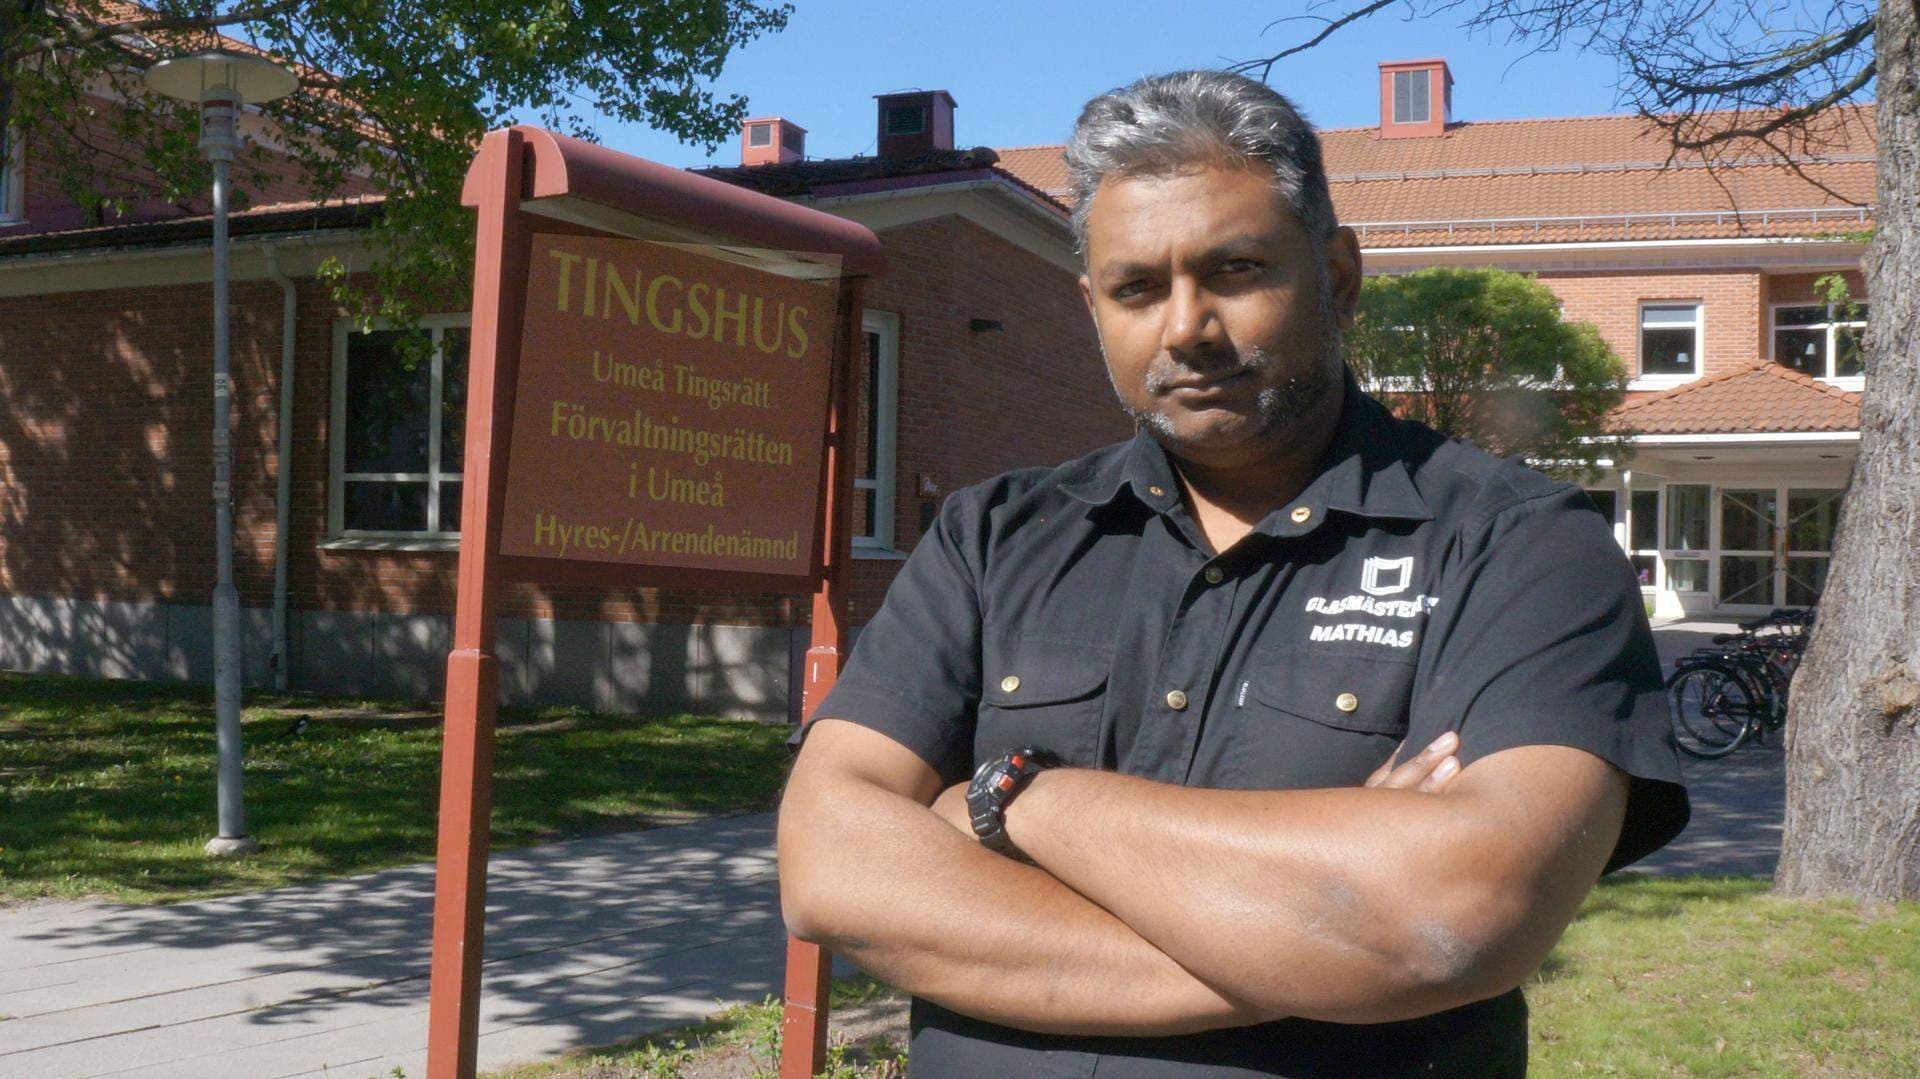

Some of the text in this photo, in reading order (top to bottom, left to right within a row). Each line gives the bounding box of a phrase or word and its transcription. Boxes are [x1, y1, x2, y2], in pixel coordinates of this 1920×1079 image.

[550, 250, 809, 358] TINGSHUS
[592, 350, 770, 410] Umeå Tingsrätt
[551, 401, 792, 466] Förvaltningsrätten
[629, 463, 724, 506] i Umeå
[534, 513, 799, 560] Hyres-/Arrendenämnd
[1309, 624, 1414, 648] MATHIAS
